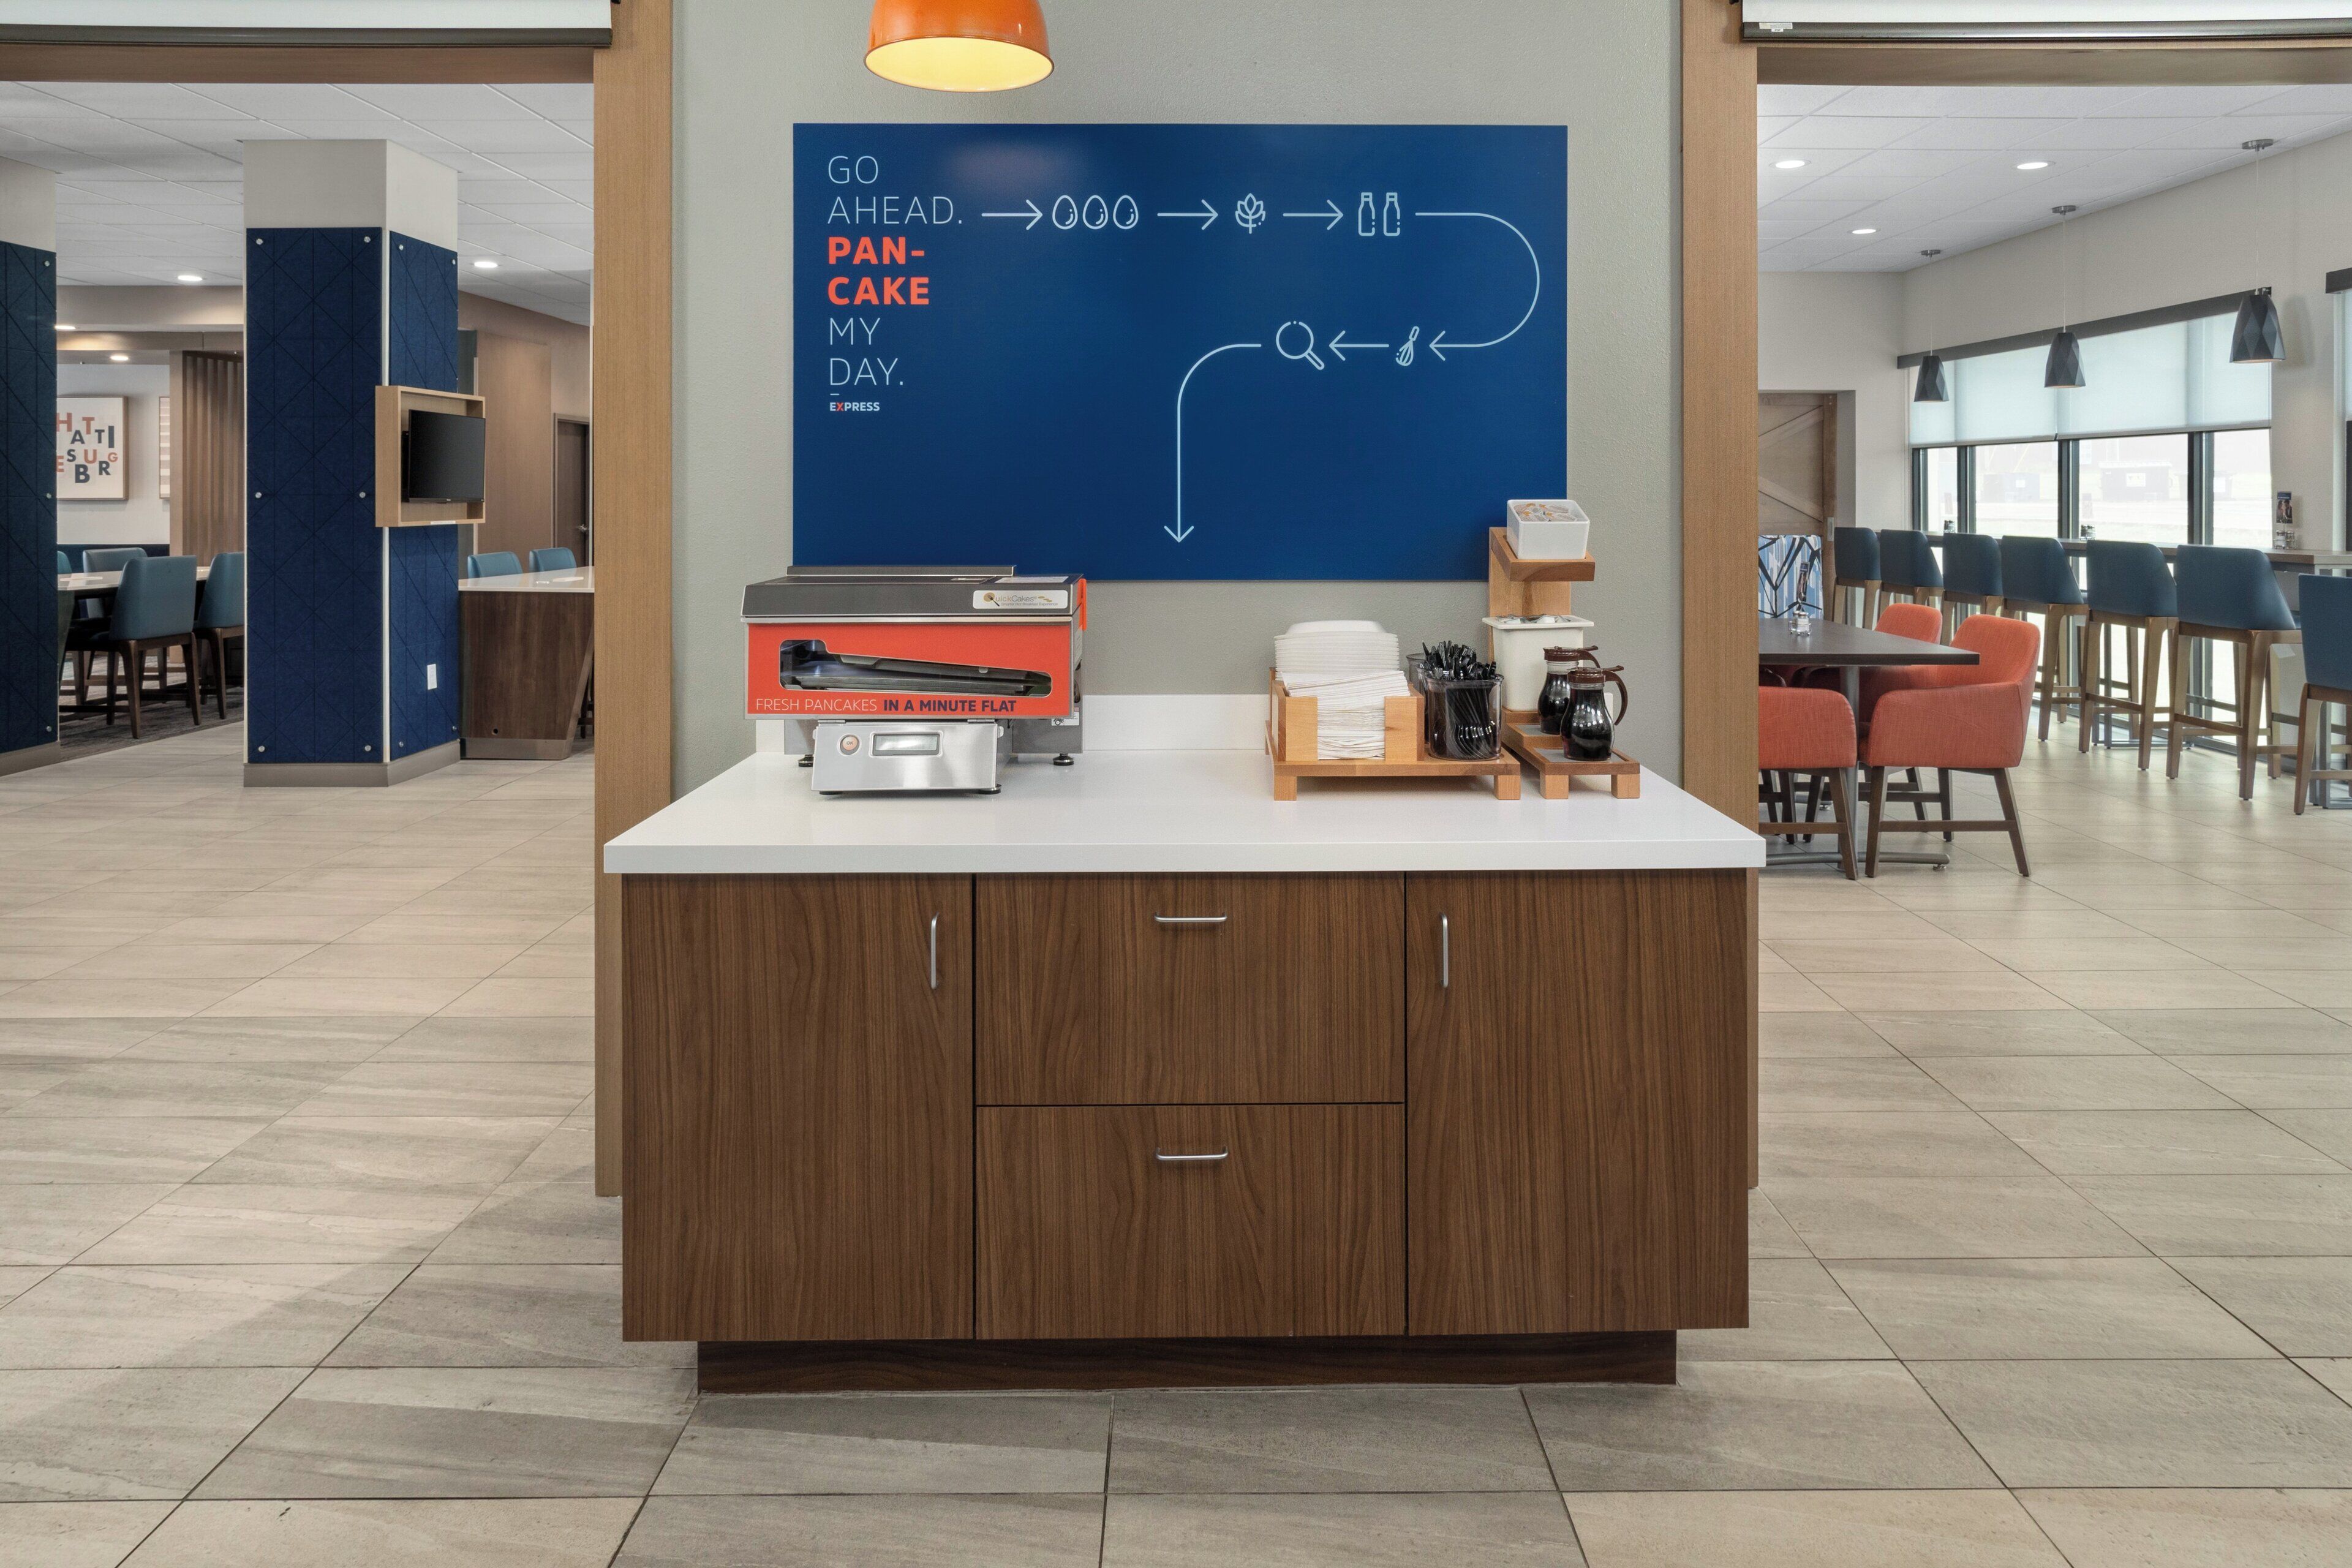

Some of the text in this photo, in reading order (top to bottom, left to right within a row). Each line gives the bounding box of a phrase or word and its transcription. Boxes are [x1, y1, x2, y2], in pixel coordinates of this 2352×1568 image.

[828, 156, 878, 184] GO
[827, 196, 962, 224] AHEAD.
[828, 236, 925, 265] PAN-
[828, 277, 929, 305] CAKE
[830, 317, 881, 345] MY
[830, 358, 903, 386] DAY.
[830, 402, 880, 412] EXPRESS
[756, 699, 1017, 711] FRESH PANCAKES IN A MINUTE FLAT
